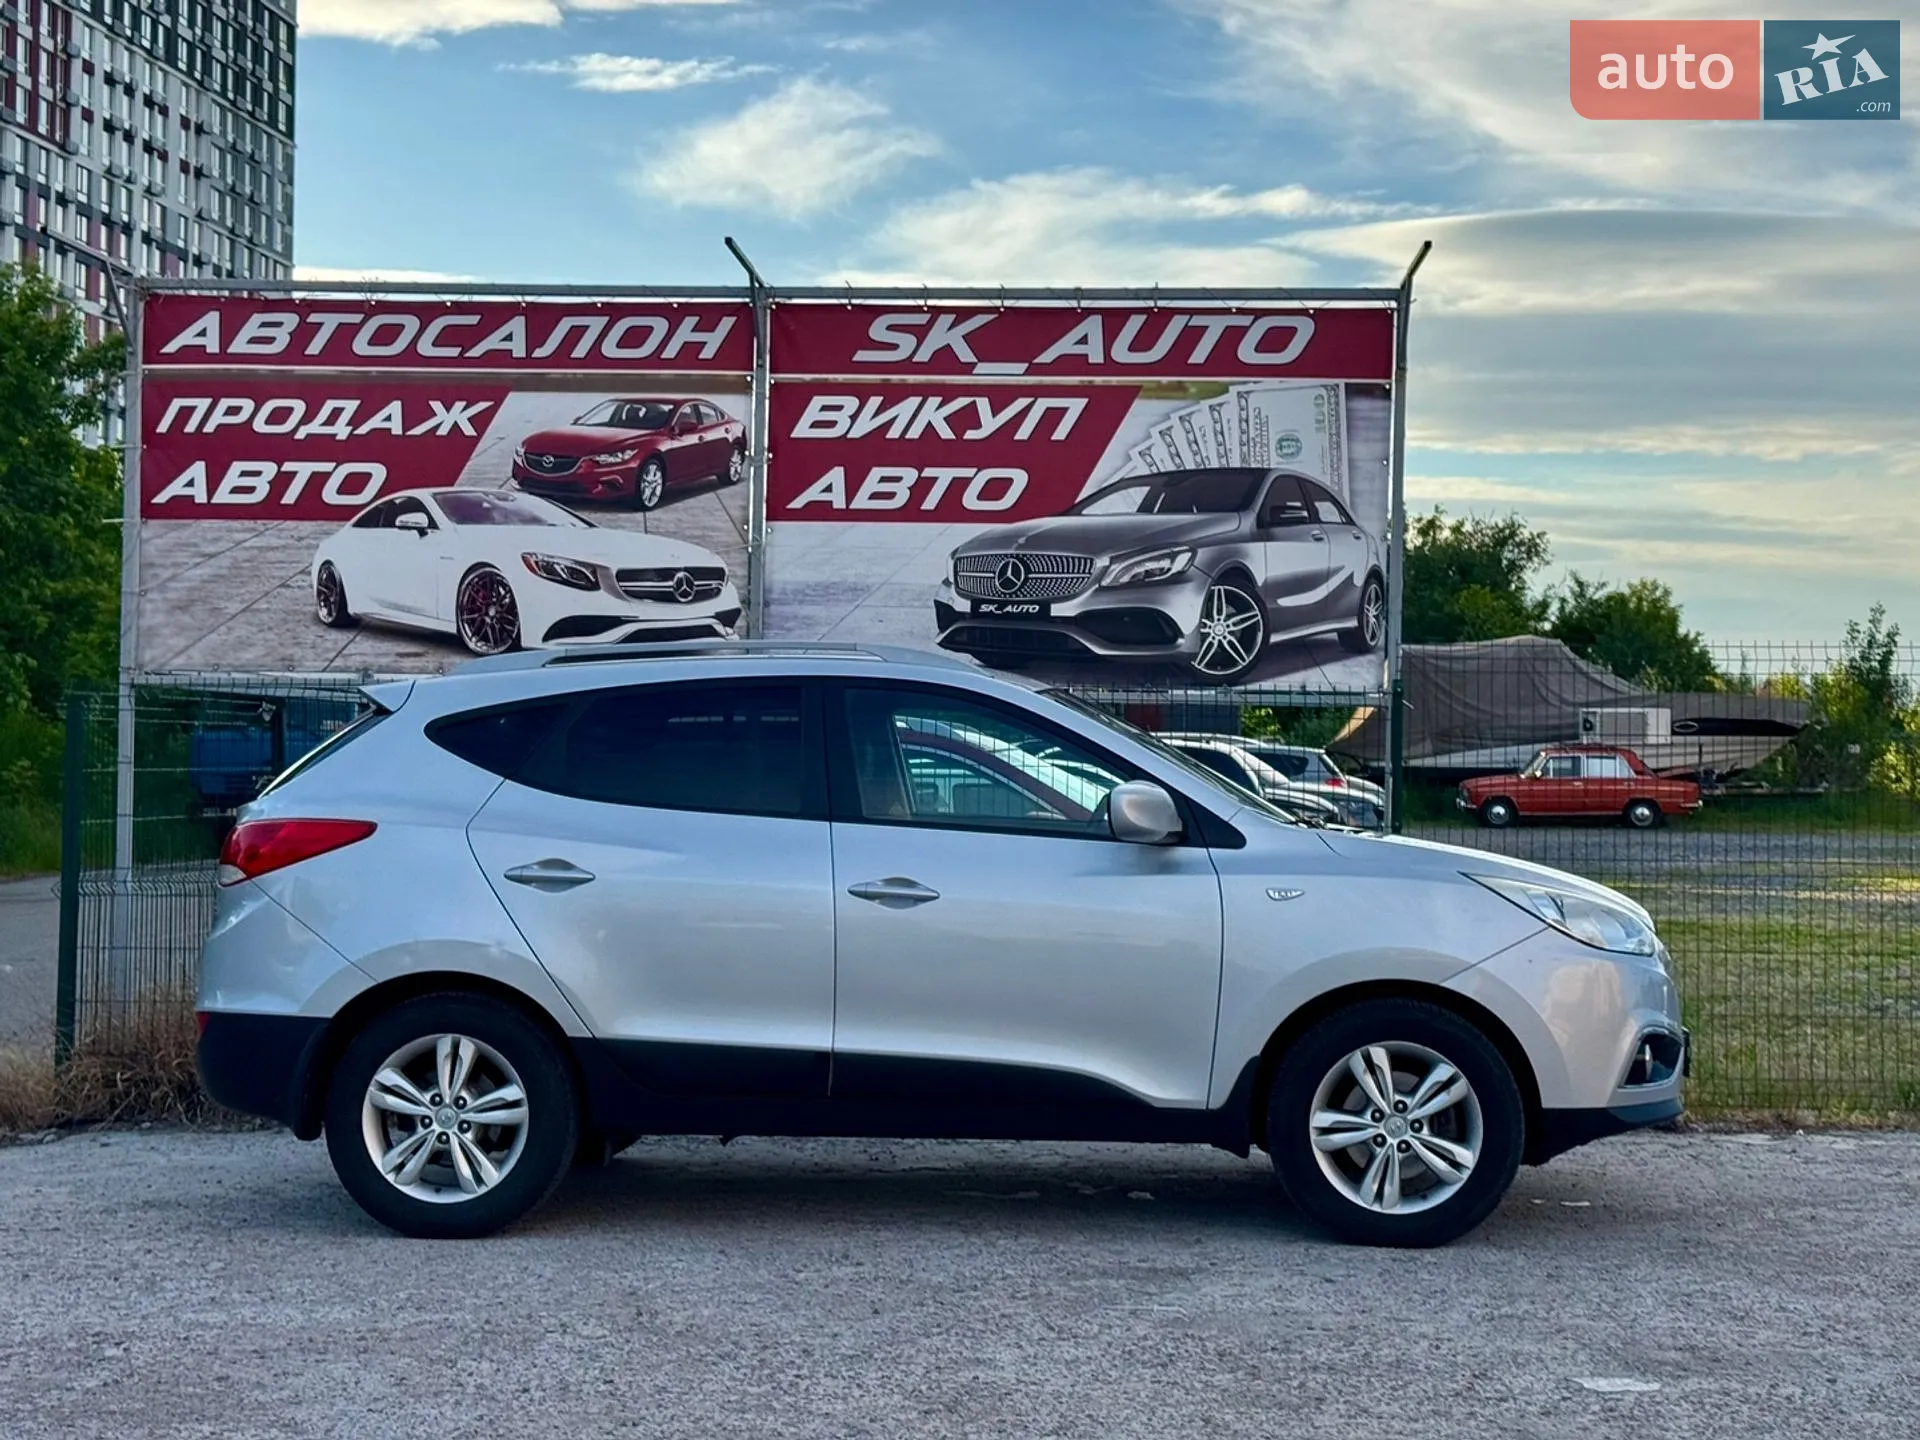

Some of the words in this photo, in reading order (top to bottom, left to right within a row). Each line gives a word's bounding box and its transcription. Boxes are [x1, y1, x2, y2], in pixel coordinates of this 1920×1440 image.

[159, 310, 738, 359] АВТОСАЛОН
[852, 312, 1316, 376] SK_AUTO
[155, 397, 495, 441] ПРОДАЖ
[790, 395, 1089, 441] ВИКУП
[150, 460, 388, 506] АВТО
[786, 466, 1030, 511] АВТО
[978, 603, 1040, 614] SK_AUTO
